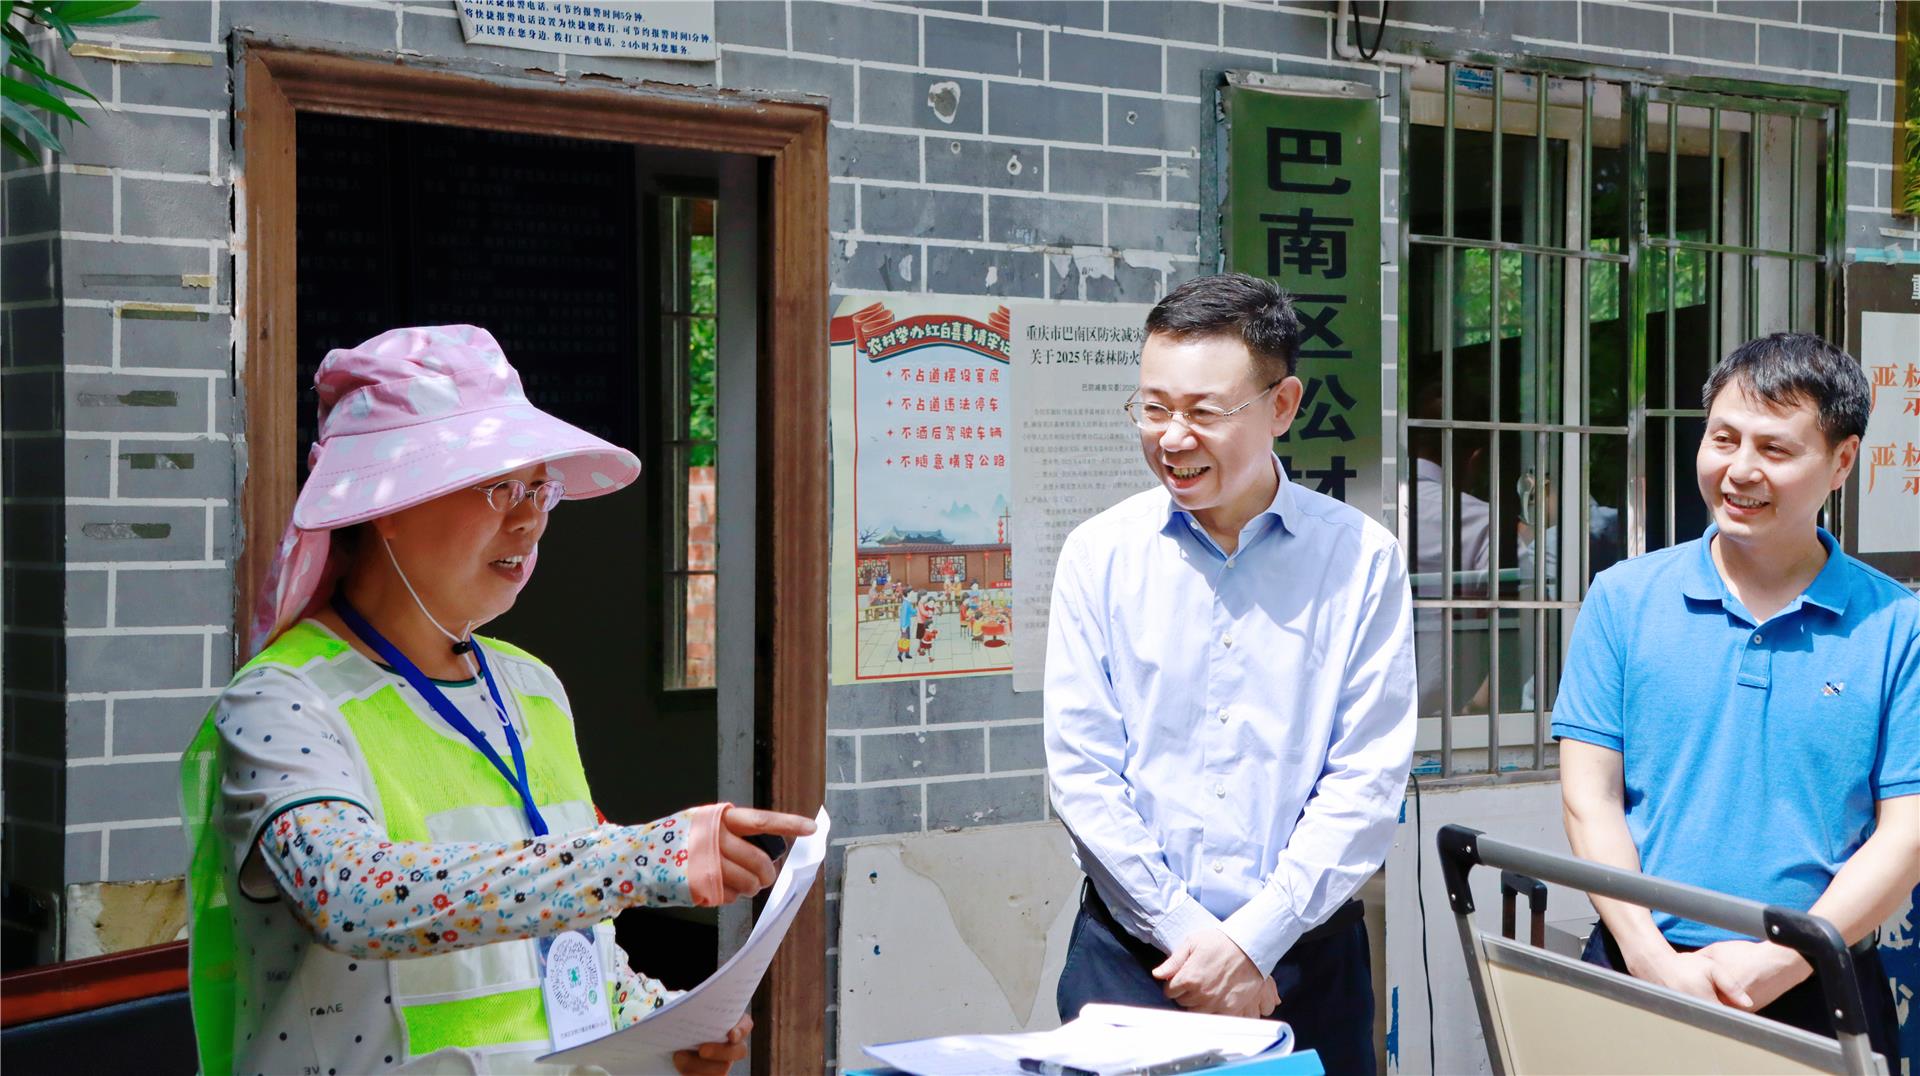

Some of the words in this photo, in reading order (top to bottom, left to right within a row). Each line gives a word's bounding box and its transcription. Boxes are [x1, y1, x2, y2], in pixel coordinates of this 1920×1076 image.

[901, 368, 1000, 383] 不占道摆设宴席
[901, 396, 999, 412] 不占道违法停车
[901, 425, 1003, 440] 不酒后驾驶车辆
[900, 452, 1006, 470] 不随意横穿公路
